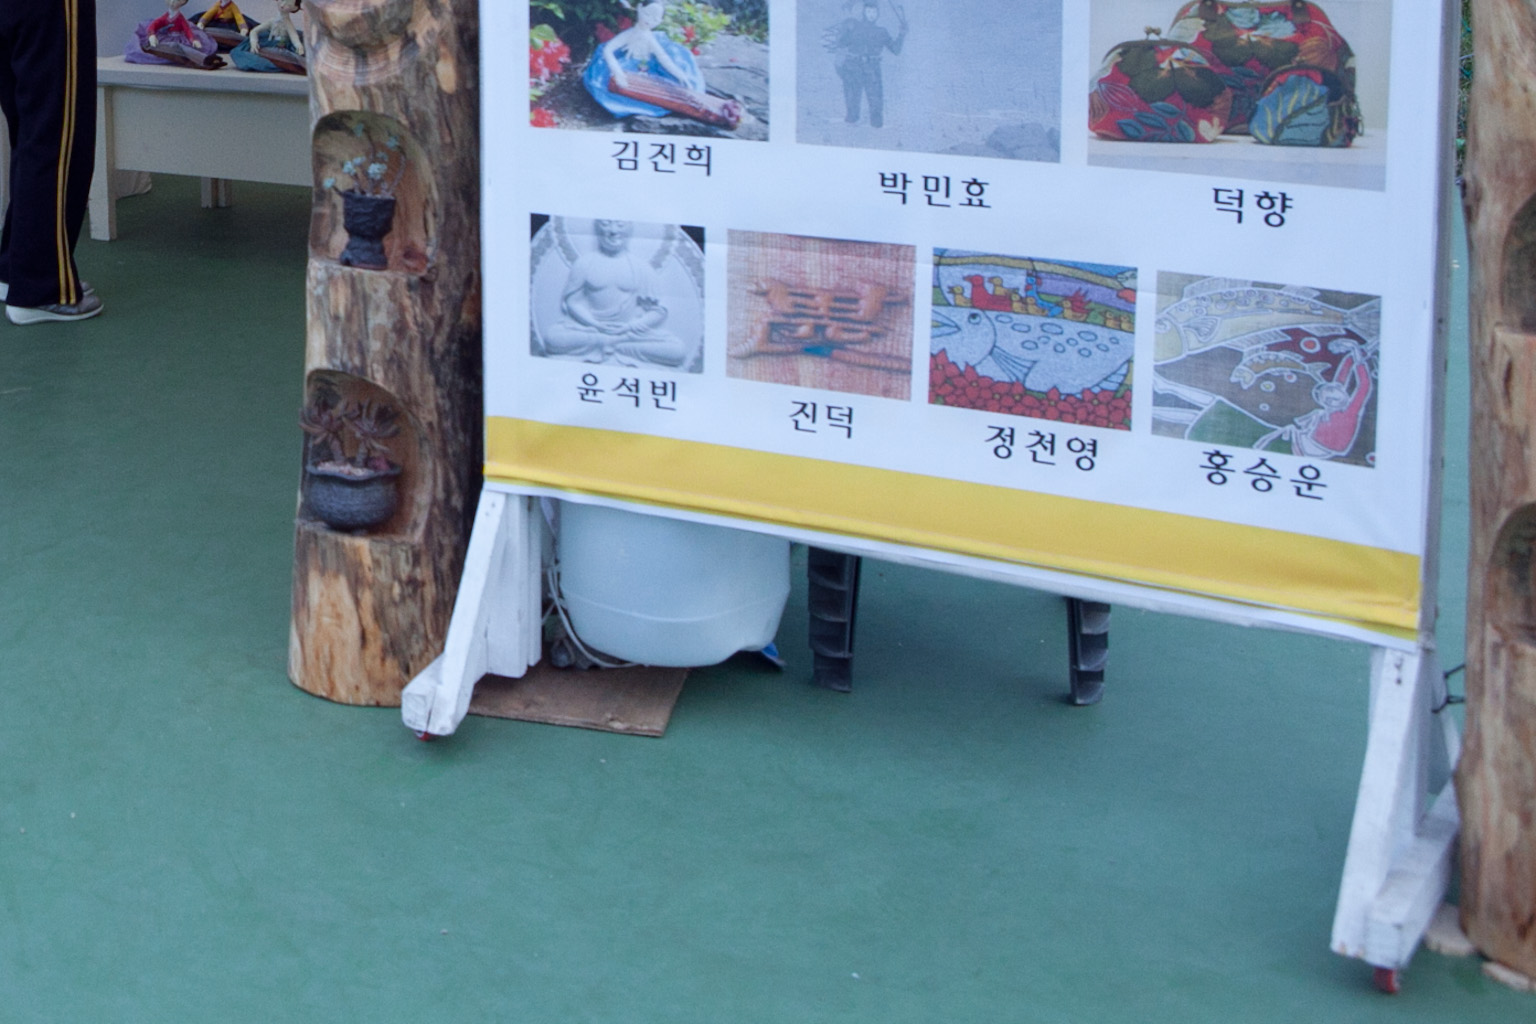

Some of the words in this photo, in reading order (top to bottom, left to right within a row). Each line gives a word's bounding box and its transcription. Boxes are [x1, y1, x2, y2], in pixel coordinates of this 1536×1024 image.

[611, 140, 714, 177] 김진희
[878, 171, 992, 209] 박민효
[1211, 187, 1294, 228] 덕향
[575, 373, 678, 411] 윤석빈
[789, 399, 855, 439] 진덕
[985, 424, 1100, 473] 정천영
[1200, 449, 1328, 501] 홍승운
